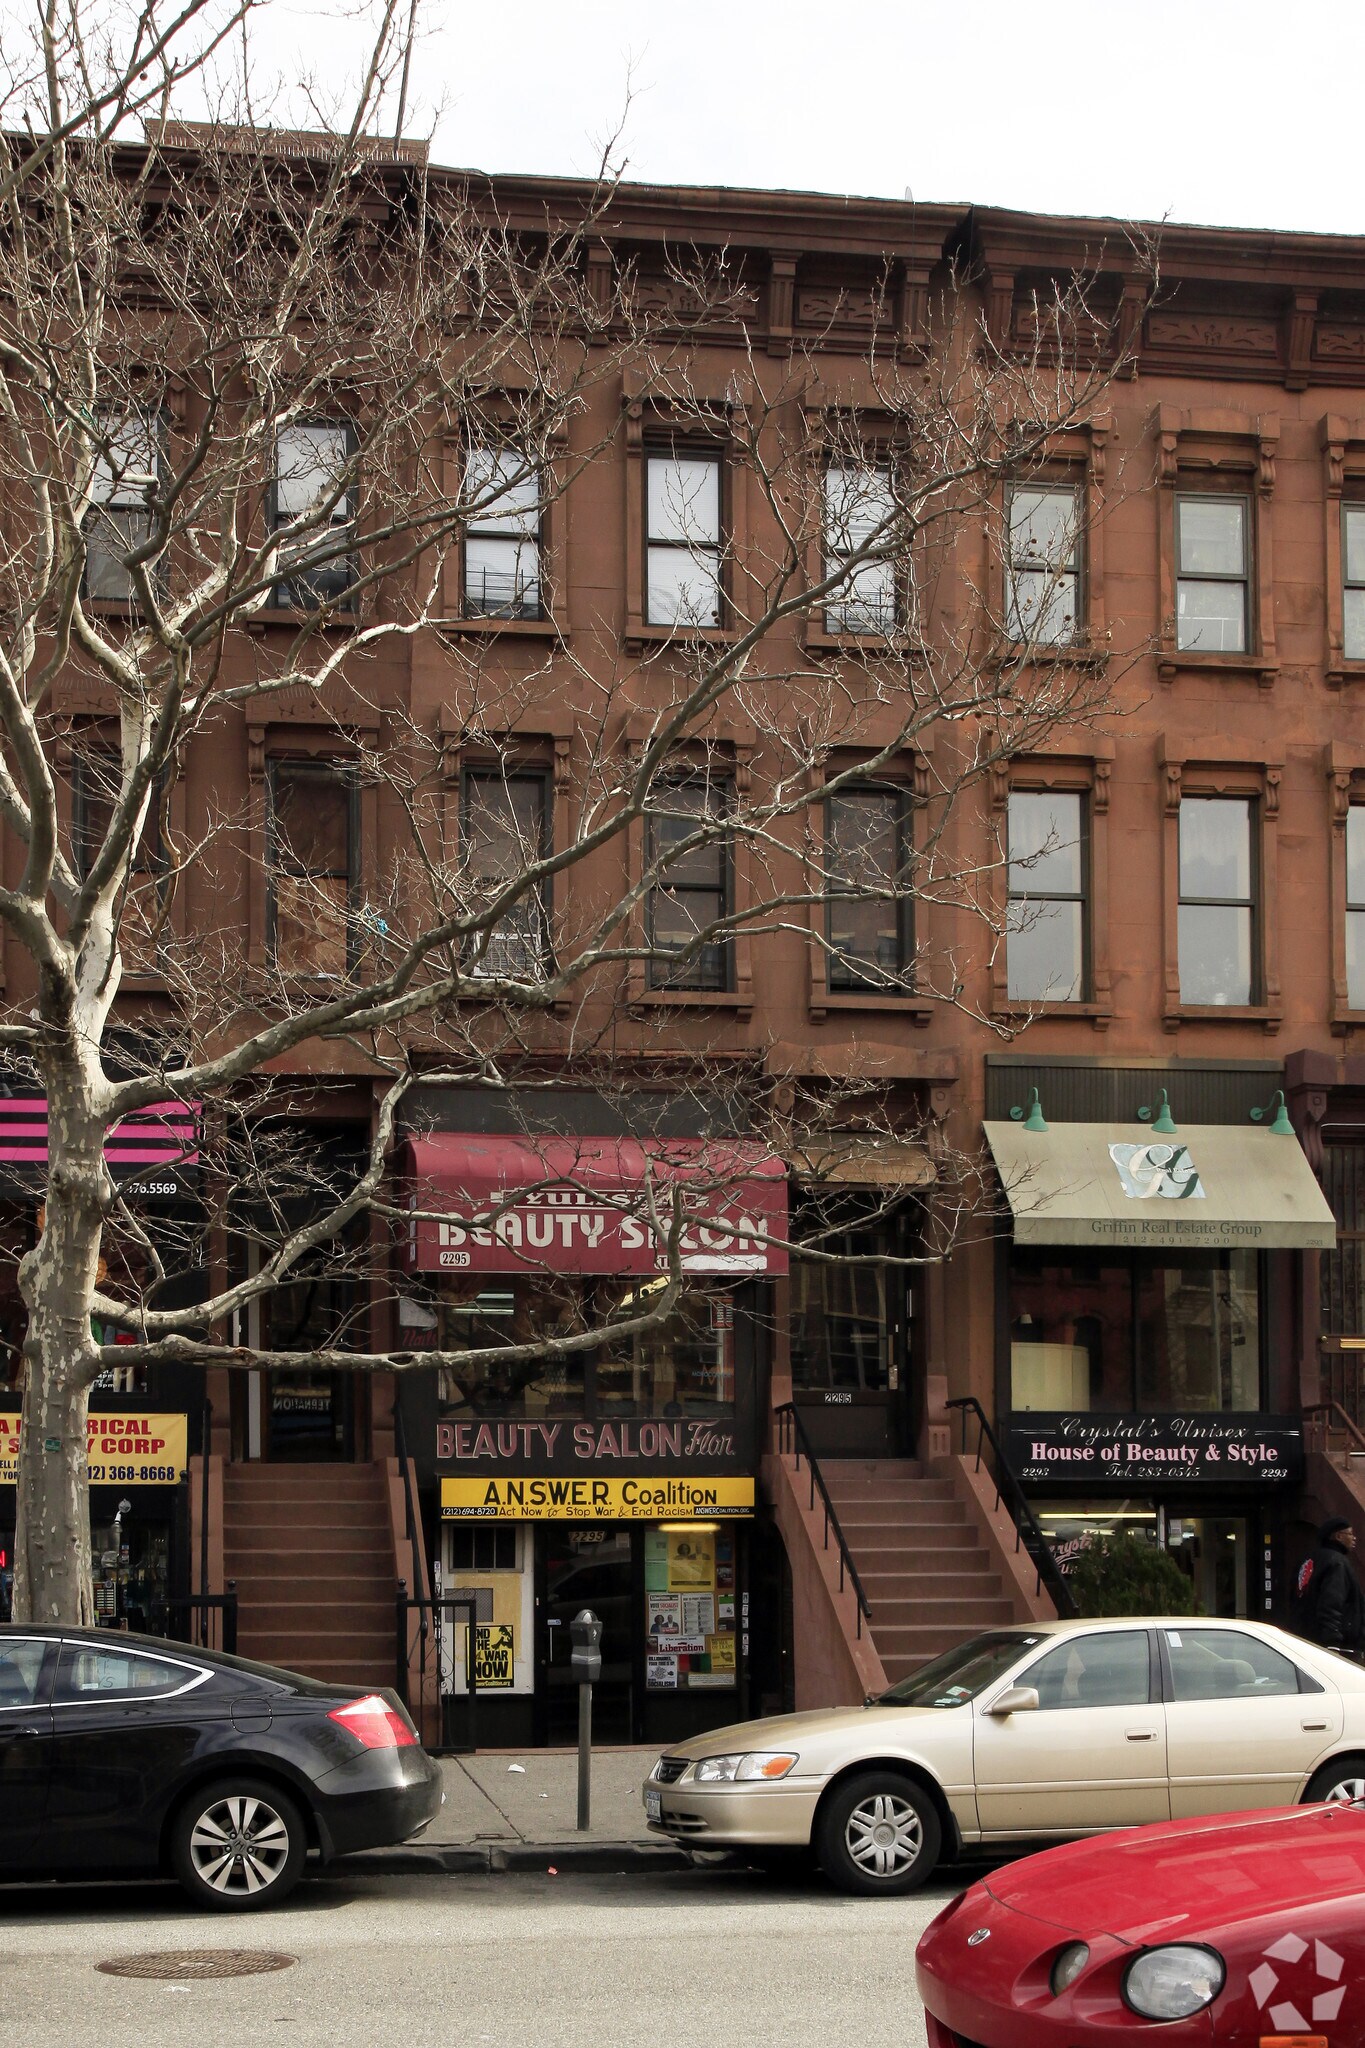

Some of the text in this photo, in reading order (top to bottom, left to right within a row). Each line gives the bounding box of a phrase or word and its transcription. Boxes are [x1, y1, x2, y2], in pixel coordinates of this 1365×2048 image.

[1092, 1220, 1262, 1237] Griffin Real Estate Group
[442, 1253, 467, 1265] 2295
[1060, 1417, 1249, 1446] Crystal's Unisex
[101, 1438, 165, 1454] CORP
[436, 1424, 562, 1458] BEAUTY
[573, 1423, 682, 1458] SALON
[1031, 1442, 1278, 1466] House of Beauty & Style
[109, 1466, 175, 1481] 368-8668
[1022, 1467, 1050, 1477] 2293
[1261, 1468, 1288, 1478] 2293
[483, 1481, 613, 1506] A.N.S.W.E.R.
[499, 1506, 516, 1517] Act
[521, 1506, 542, 1517] Now
[546, 1507, 562, 1518] to
[565, 1506, 591, 1518] Stop
[595, 1506, 615, 1517] War
[617, 1506, 629, 1518] &
[631, 1506, 653, 1516] End
[571, 1531, 604, 1542] 2295
[476, 1628, 490, 1639] ND
[476, 1640, 490, 1650] HE
[660, 1644, 704, 1652] Liberation
[484, 1650, 508, 1661] WAR
[476, 1661, 508, 1678] NOW
